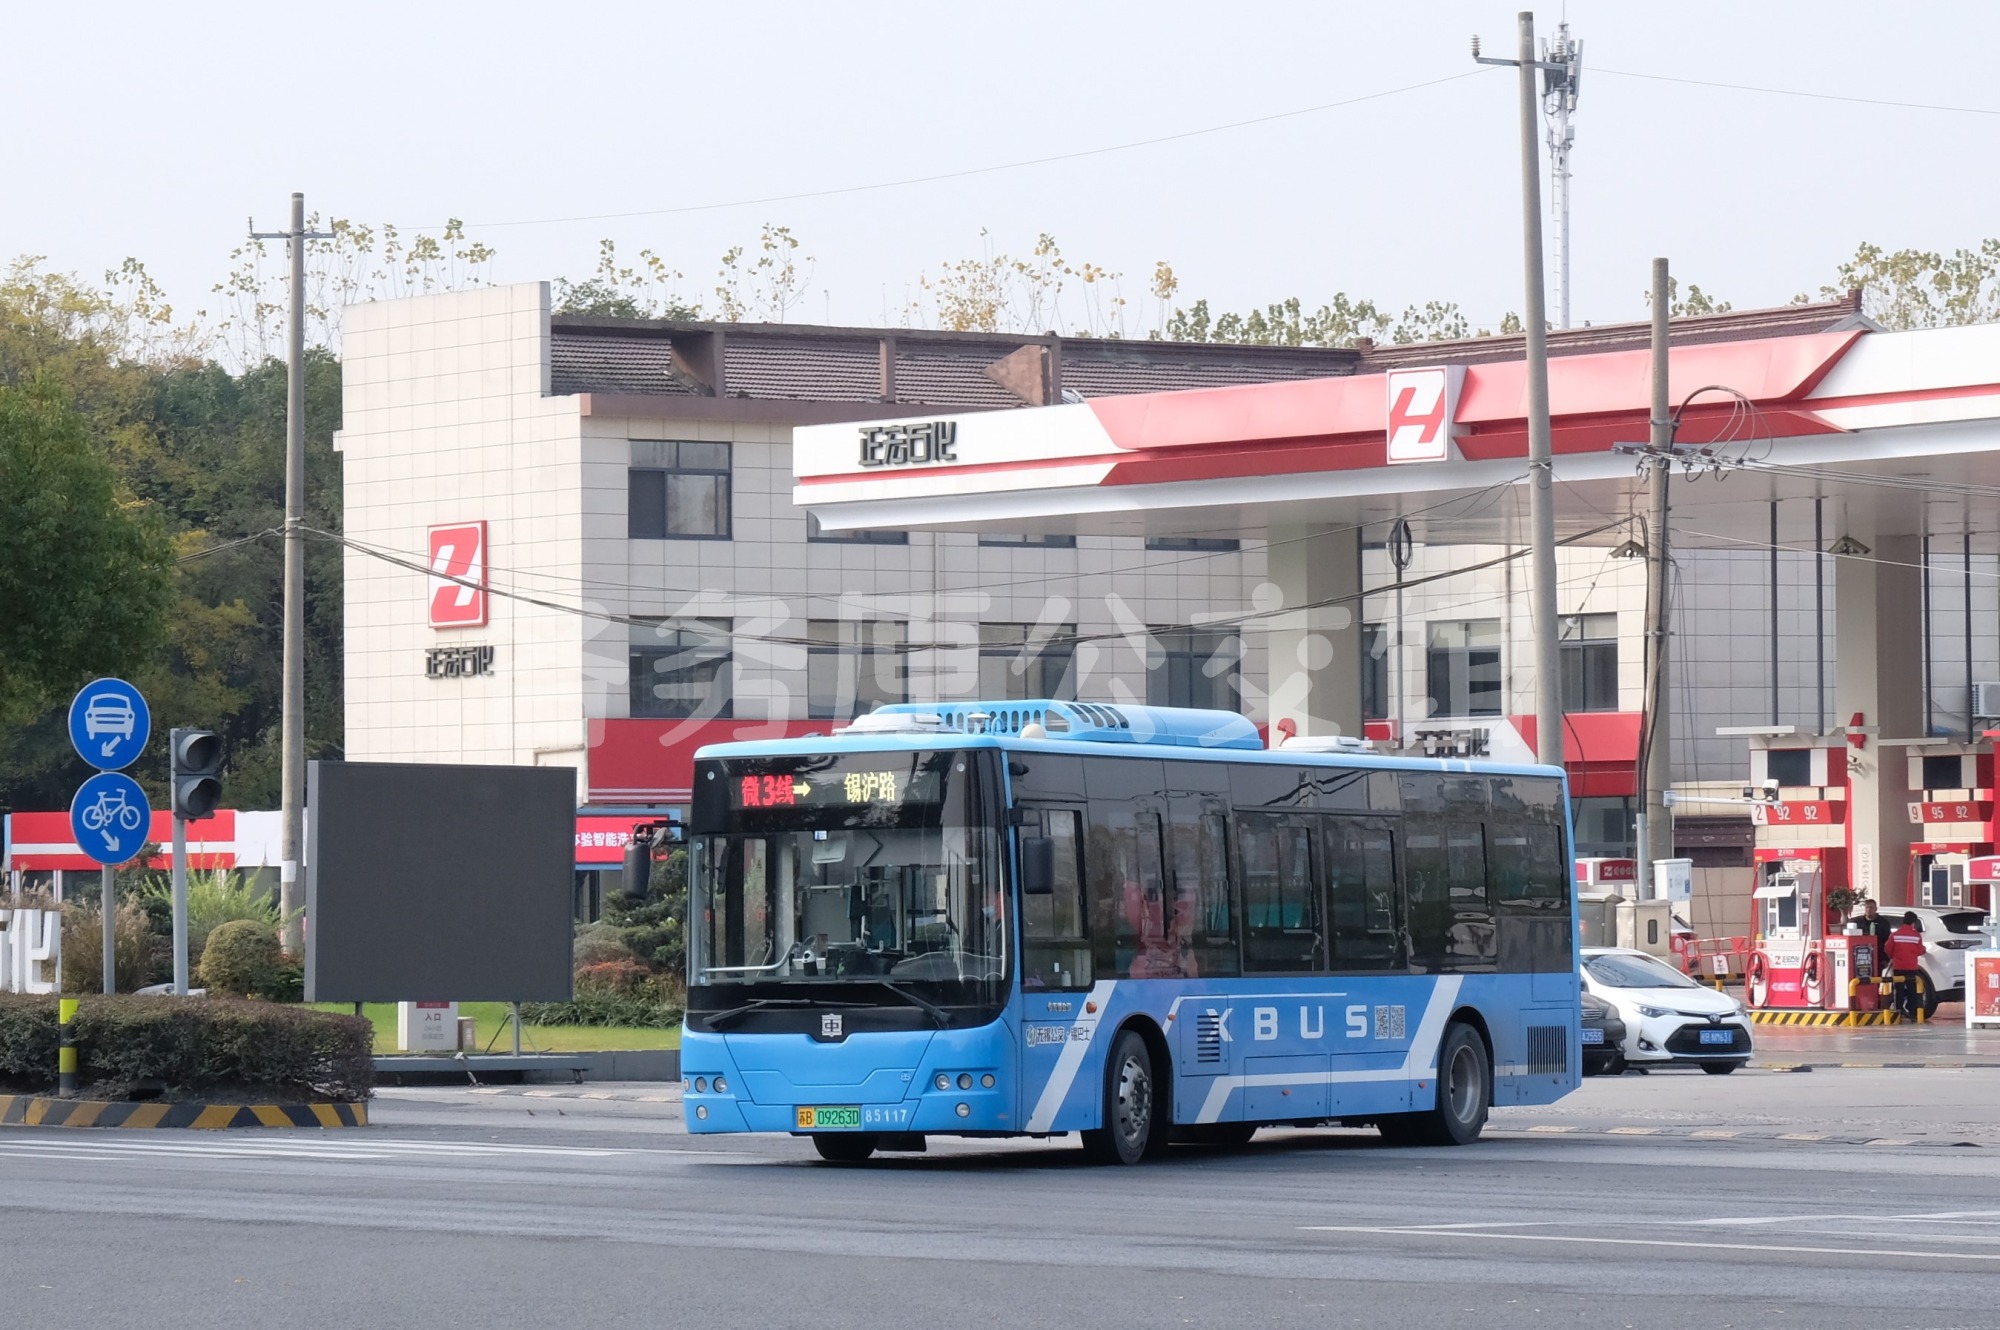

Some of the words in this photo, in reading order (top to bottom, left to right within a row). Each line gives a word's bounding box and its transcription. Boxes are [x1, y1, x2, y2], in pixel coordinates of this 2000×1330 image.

[858, 421, 957, 466] 正宏石化
[424, 646, 494, 678] 正宏石化
[844, 772, 896, 803] 锡沪路
[1804, 805, 1819, 820] 92
[1911, 806, 1919, 820] 9
[1931, 806, 1944, 819] 95
[1956, 805, 1969, 819] 92
[425, 1012, 441, 1021] 入口
[865, 1109, 908, 1123] 85117
